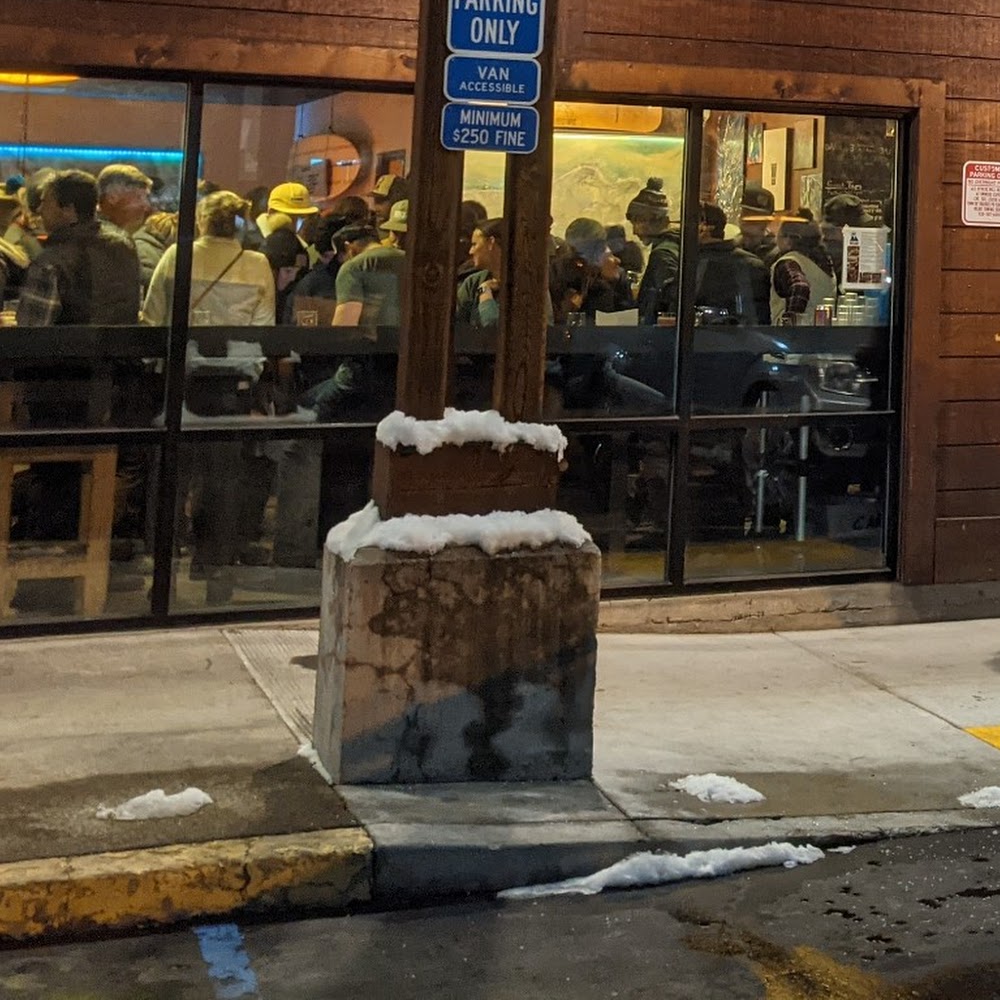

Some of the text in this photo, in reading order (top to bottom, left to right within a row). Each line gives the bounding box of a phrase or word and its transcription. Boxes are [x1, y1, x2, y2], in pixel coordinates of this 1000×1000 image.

[470, 16, 520, 46] ONLY
[478, 66, 510, 81] VAN
[459, 81, 526, 94] ACCESSIBLE
[460, 109, 521, 128] MINIMUM
[453, 128, 526, 147] $250 FINE
[970, 171, 996, 179] PARKING
